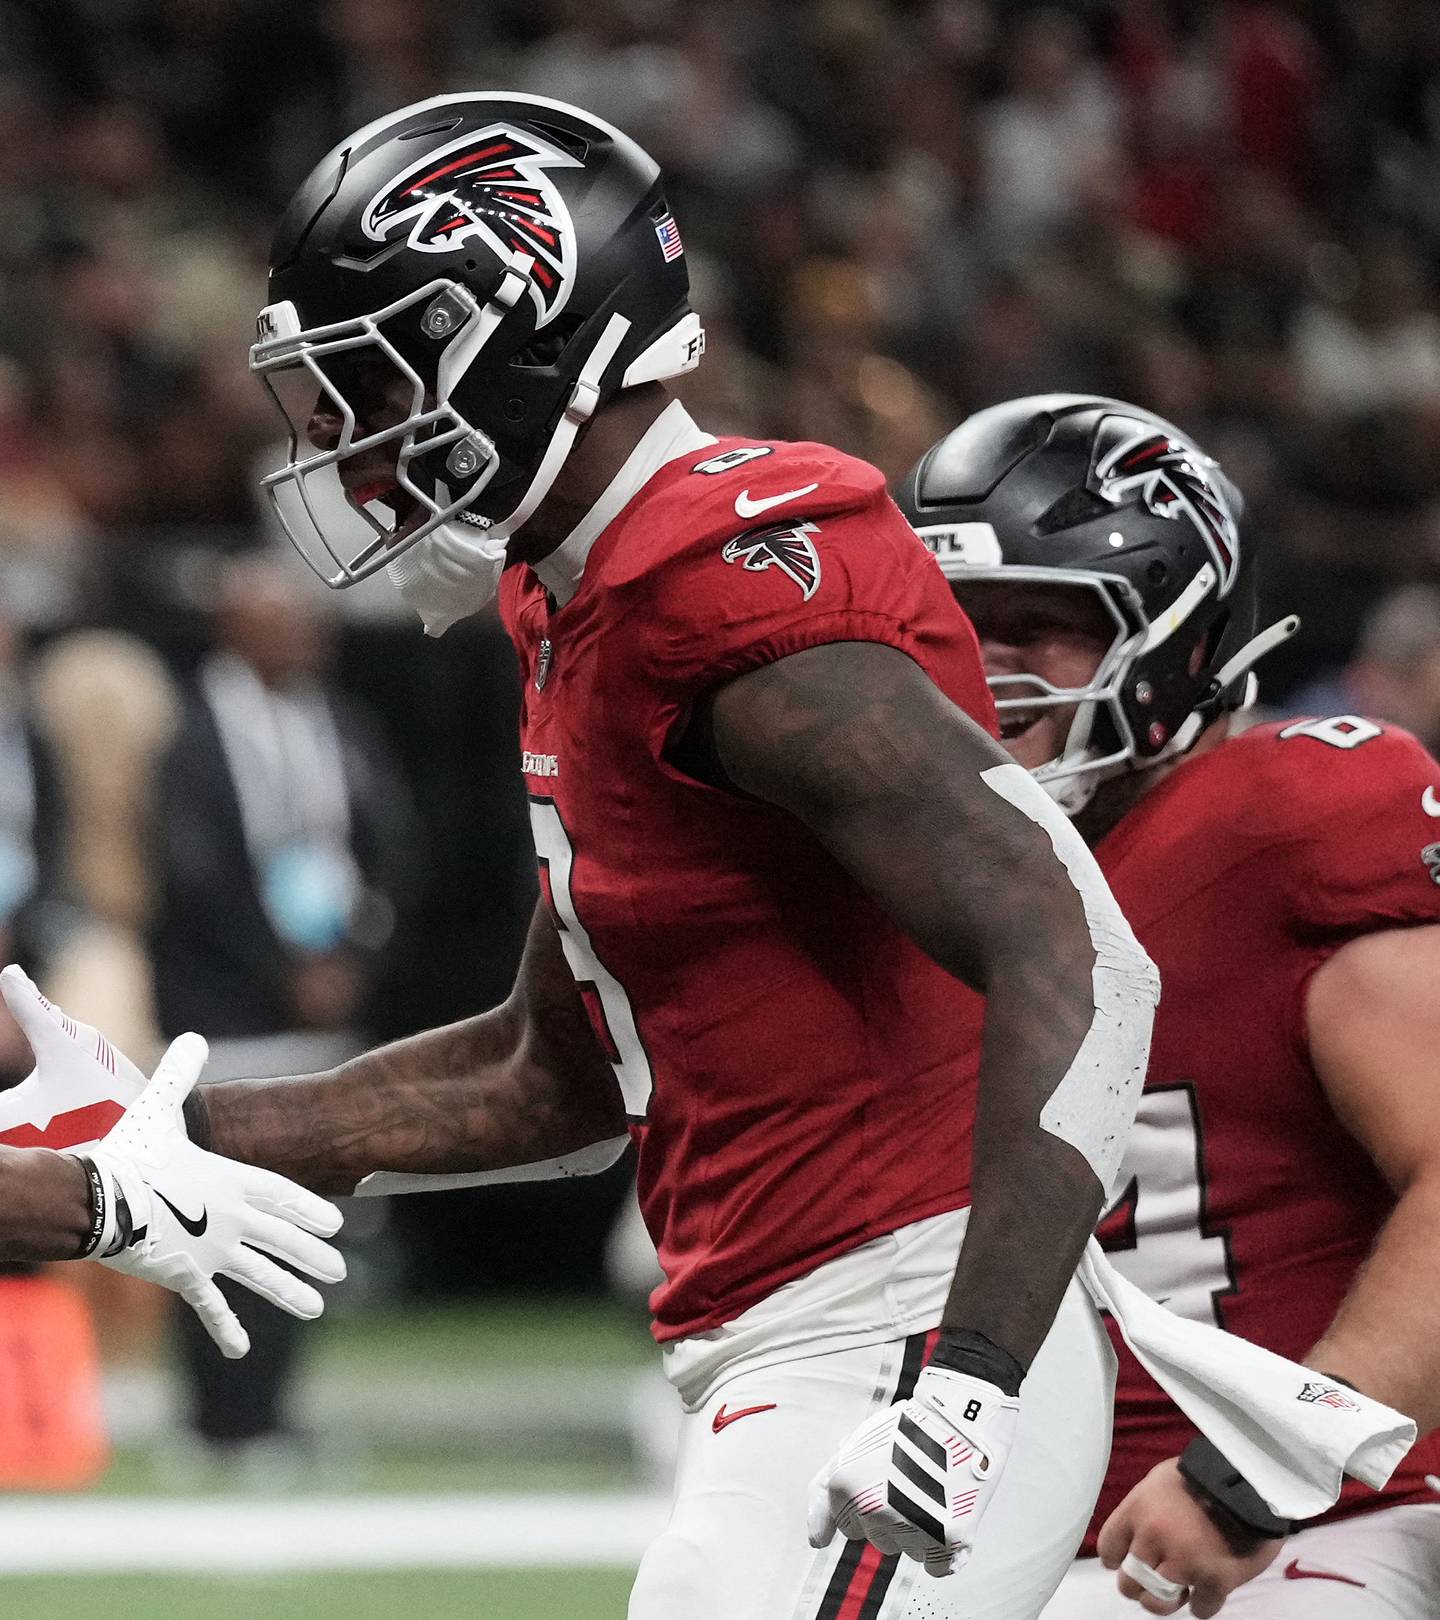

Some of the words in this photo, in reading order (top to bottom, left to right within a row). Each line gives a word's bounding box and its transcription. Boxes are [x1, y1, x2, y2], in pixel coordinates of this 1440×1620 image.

[91, 1172, 100, 1185] my
[95, 1187, 105, 1214] story
[963, 1398, 982, 1422] 8
